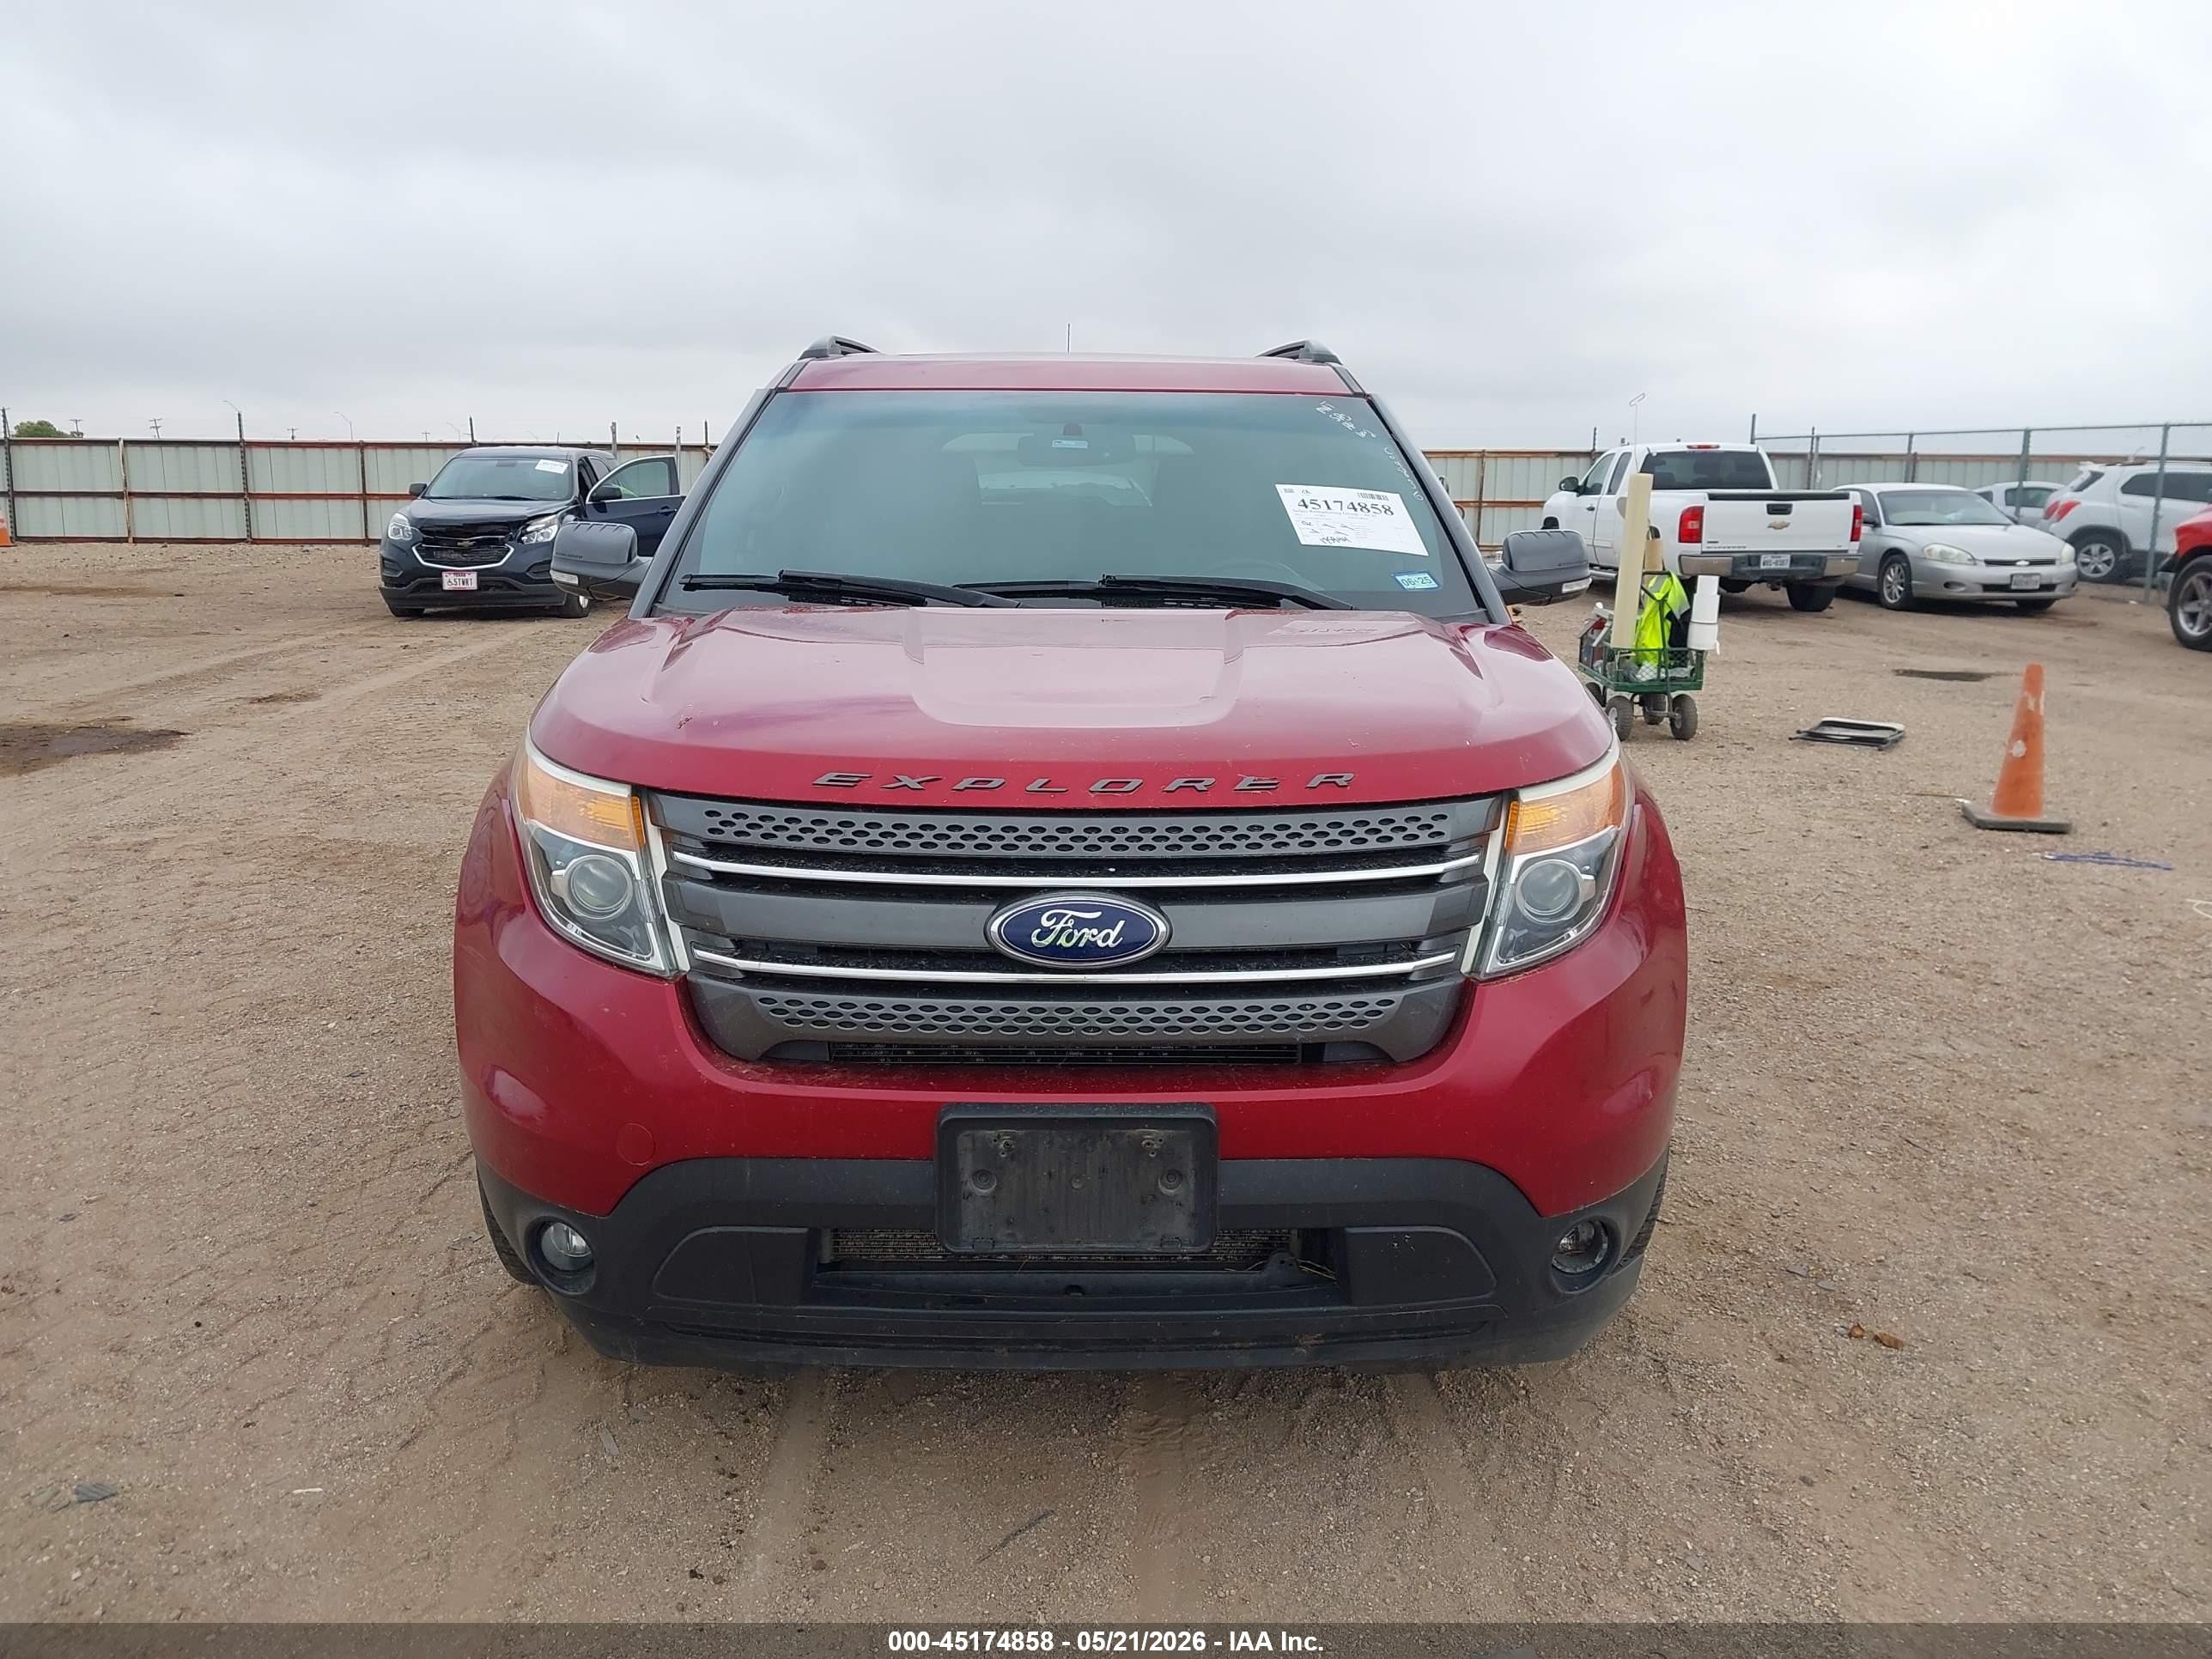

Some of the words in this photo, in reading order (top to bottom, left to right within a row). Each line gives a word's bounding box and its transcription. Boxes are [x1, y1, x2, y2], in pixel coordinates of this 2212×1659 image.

[1297, 498, 1395, 516] 45174858
[812, 772, 1355, 793] EXPLORER
[1031, 908, 1123, 949] Ford
